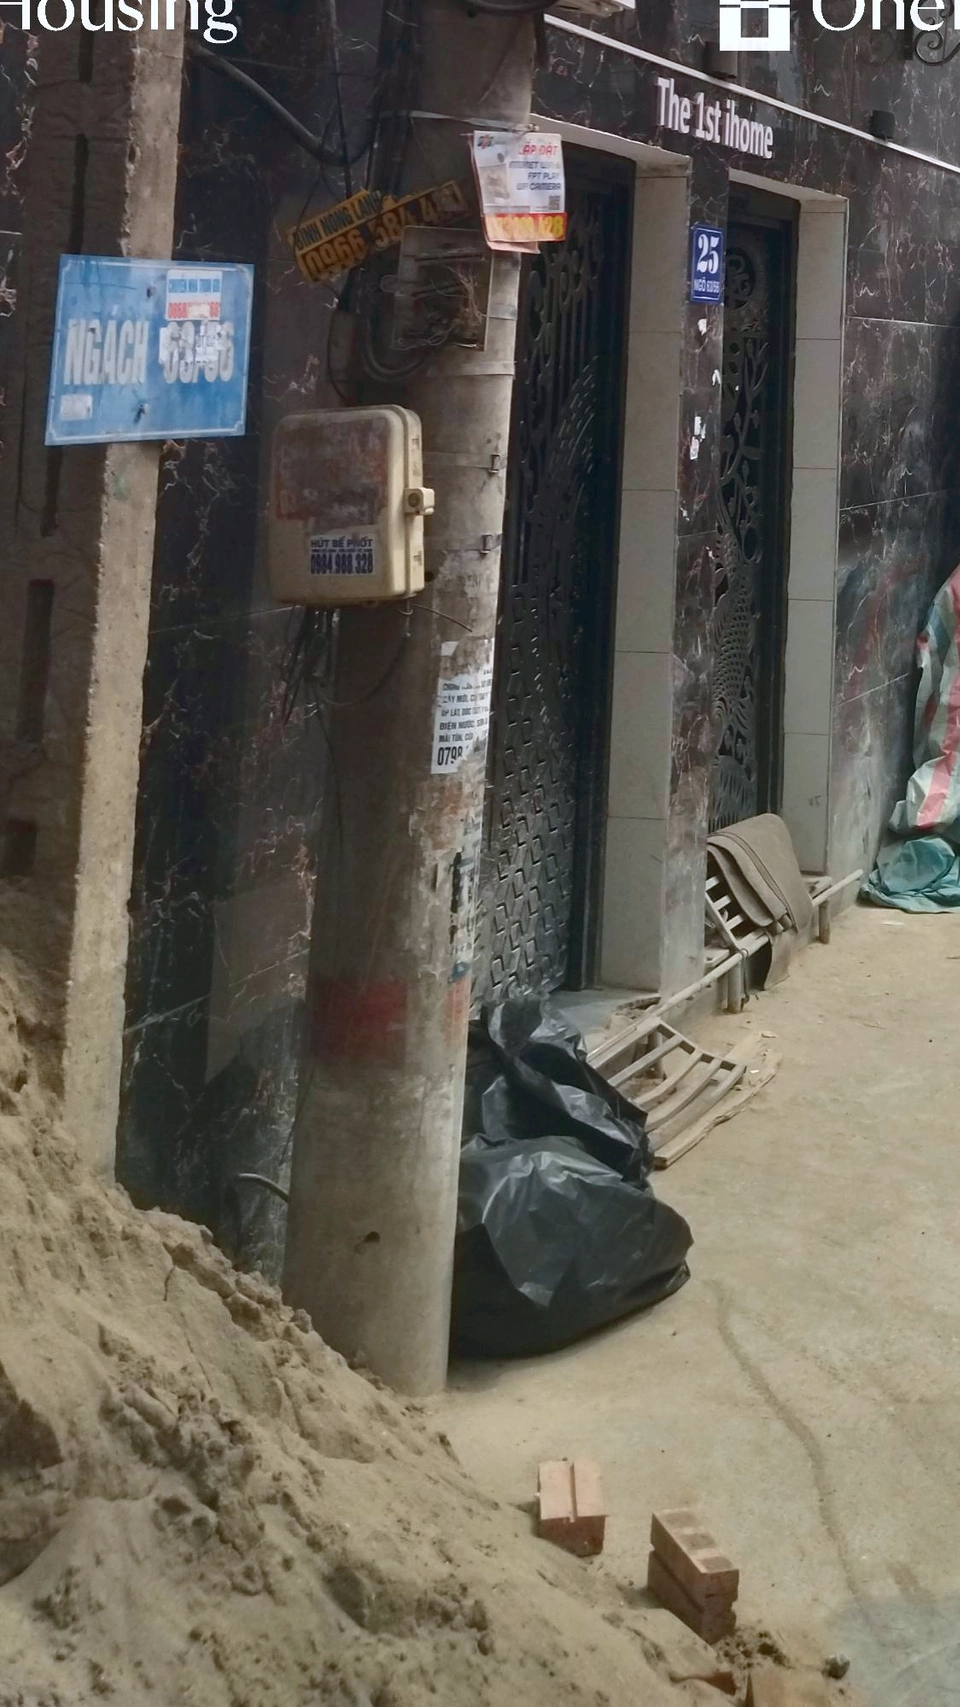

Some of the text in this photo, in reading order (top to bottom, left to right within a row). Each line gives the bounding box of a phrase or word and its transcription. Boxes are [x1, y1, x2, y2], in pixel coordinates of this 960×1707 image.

[657, 77, 773, 159] The 1st ihome
[696, 234, 720, 274] 25
[64, 305, 149, 385] NGÁCH
